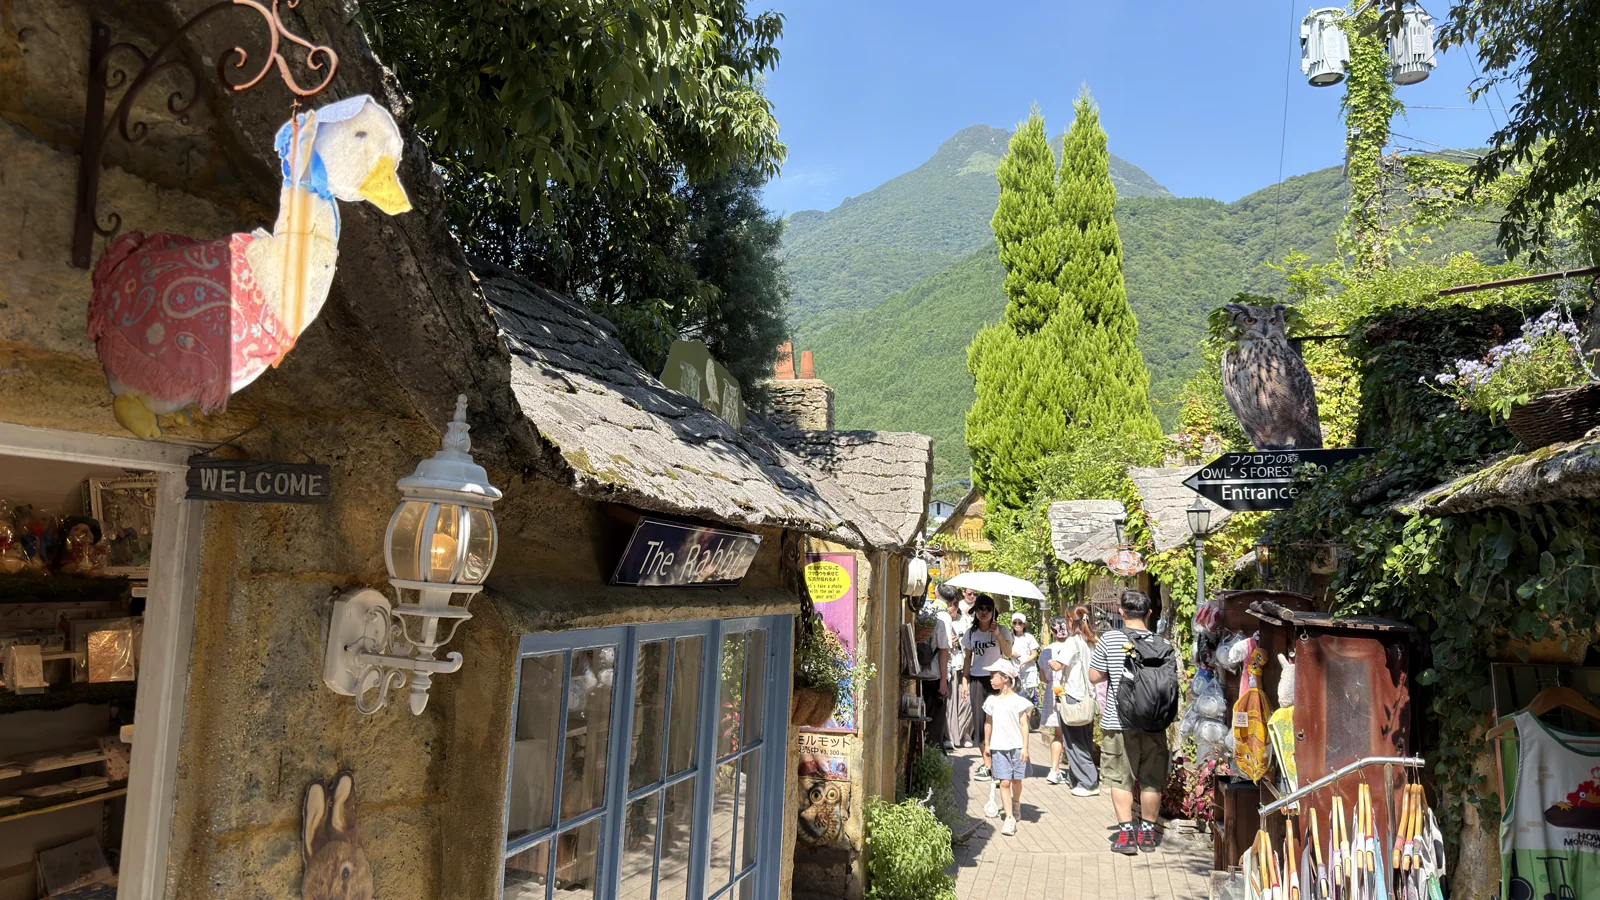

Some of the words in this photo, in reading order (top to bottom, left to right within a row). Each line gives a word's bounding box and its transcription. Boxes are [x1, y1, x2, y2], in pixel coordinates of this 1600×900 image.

[1230, 453, 1299, 466] フクロウの森
[200, 468, 323, 496] WELCOME
[1222, 485, 1299, 501] Entrance
[639, 540, 675, 576] The
[973, 640, 996, 648] Tues
